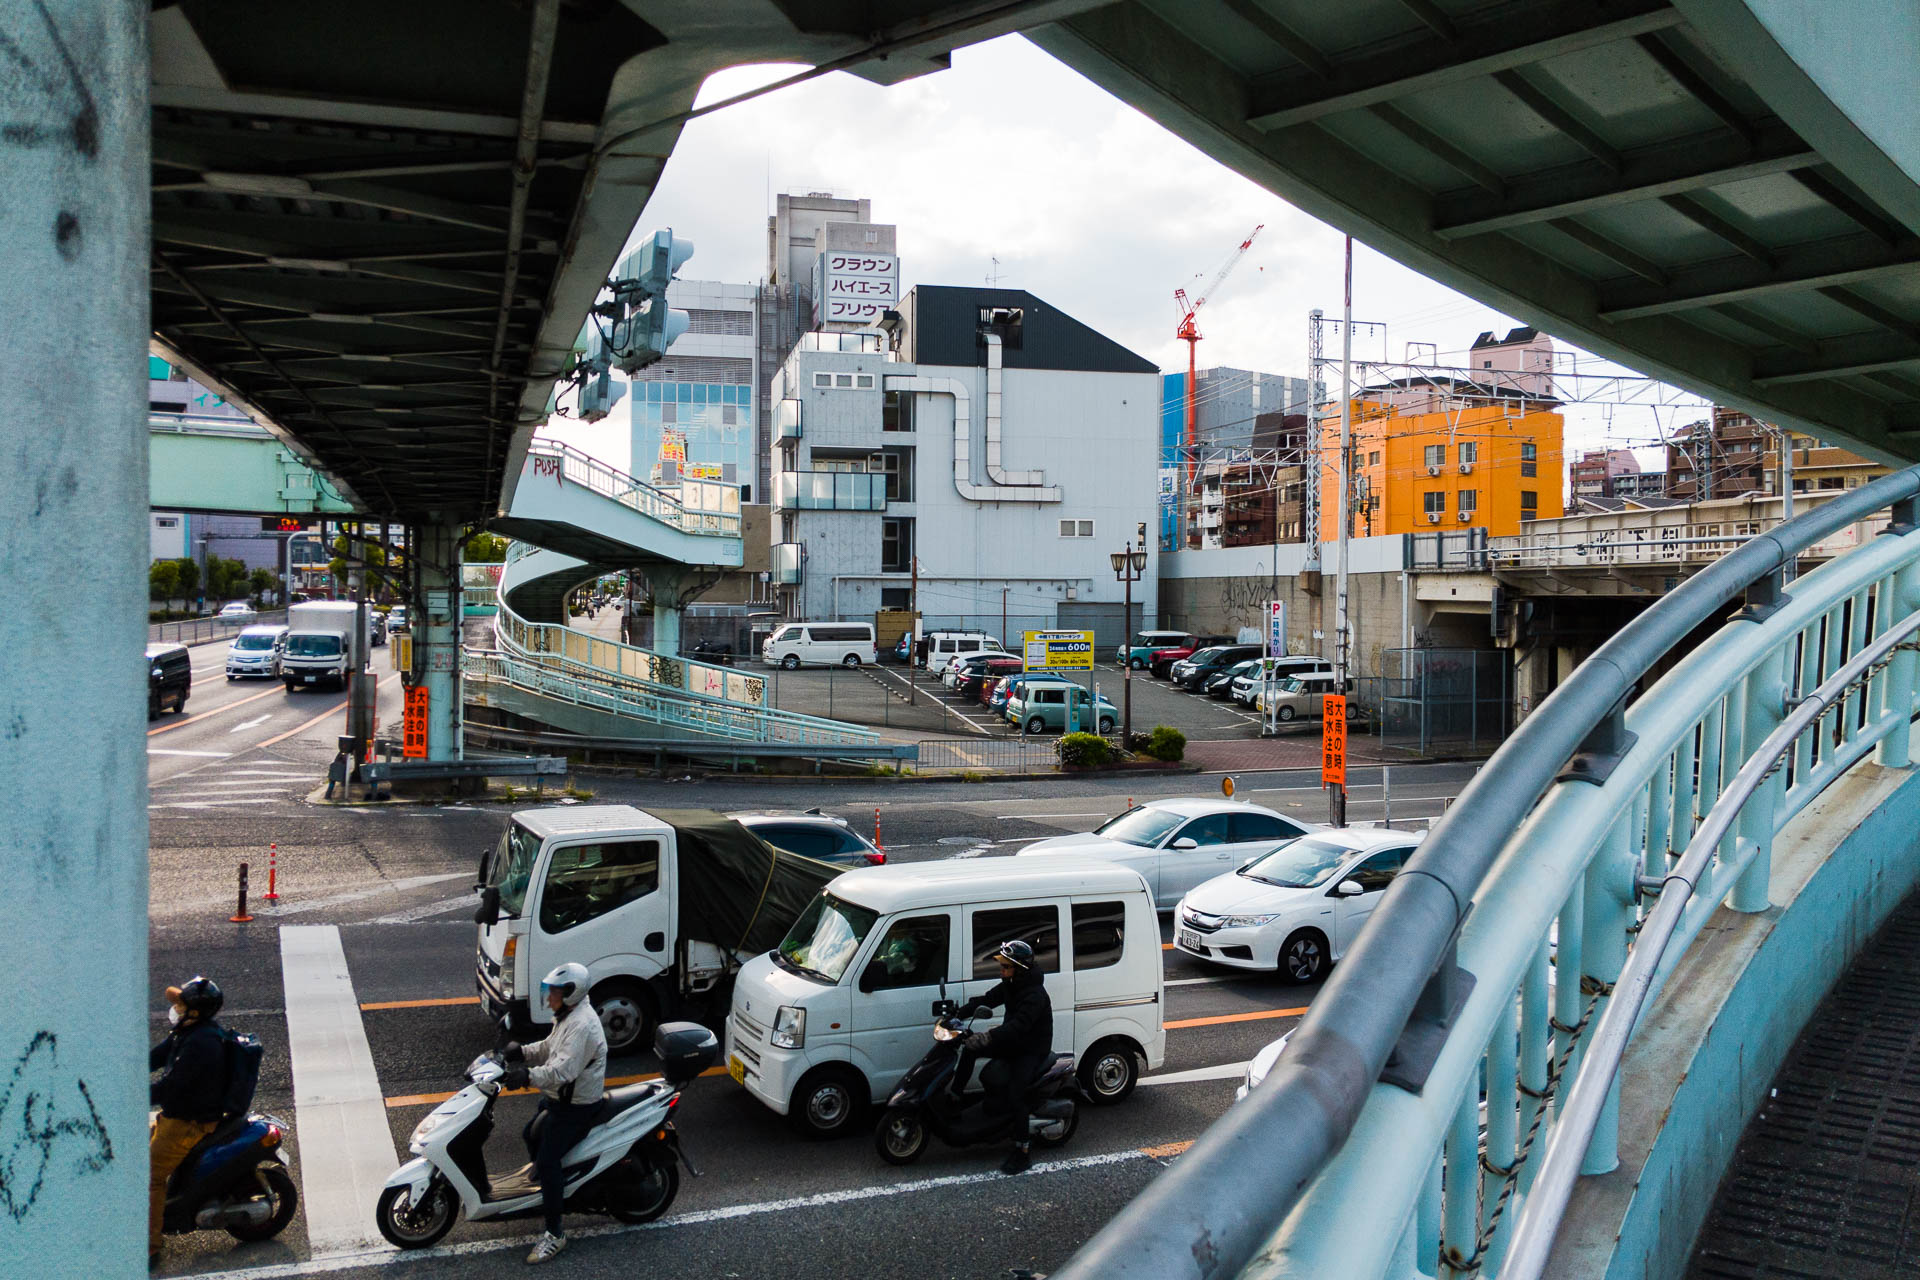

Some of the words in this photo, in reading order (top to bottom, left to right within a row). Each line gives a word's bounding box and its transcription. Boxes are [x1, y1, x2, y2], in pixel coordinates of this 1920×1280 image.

[831, 257, 892, 272] クラウン
[831, 279, 892, 295] ハイエース
[1272, 603, 1281, 616] P
